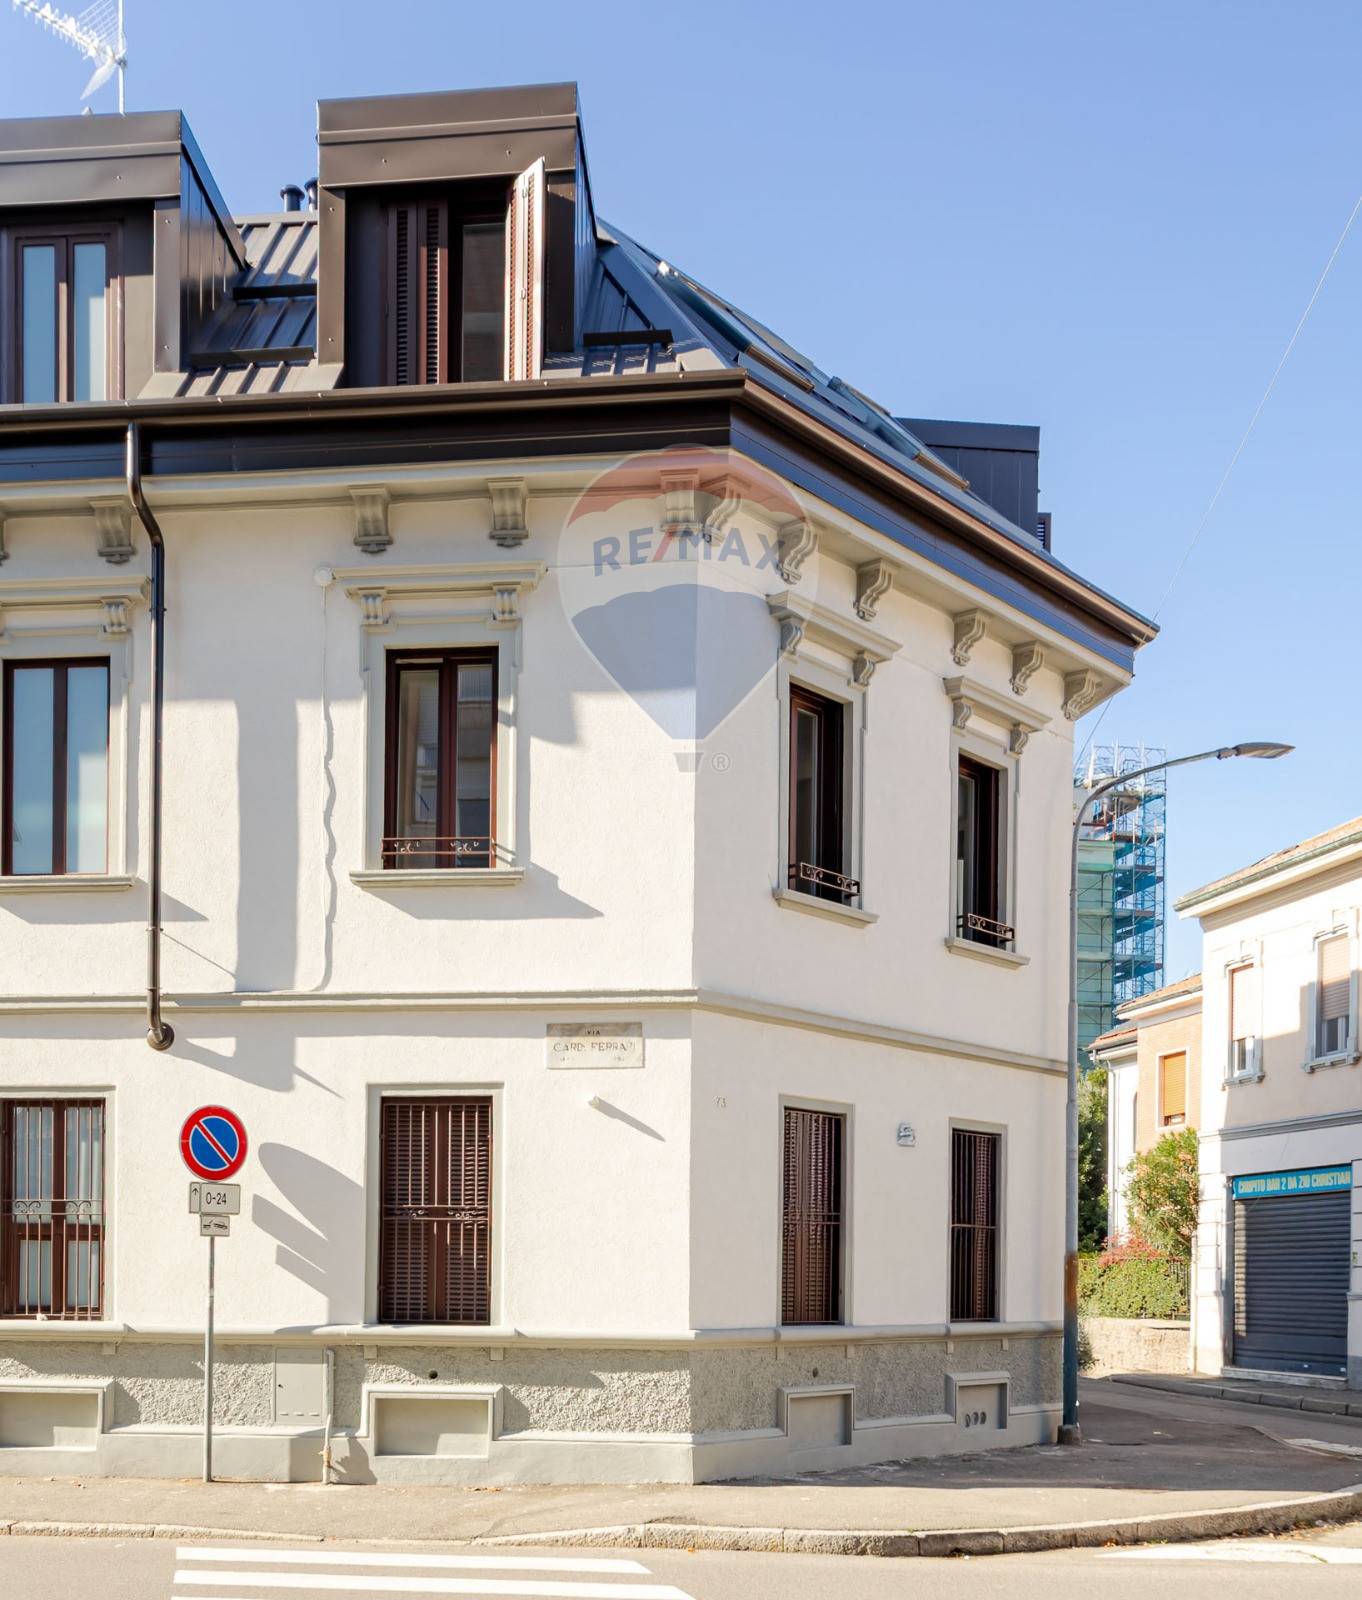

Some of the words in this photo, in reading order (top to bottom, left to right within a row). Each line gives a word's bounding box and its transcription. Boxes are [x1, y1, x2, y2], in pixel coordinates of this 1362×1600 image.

[1266, 1177, 1281, 1192] BAR
[1281, 1177, 1287, 1190] 2
[206, 1191, 227, 1205] 0-24
